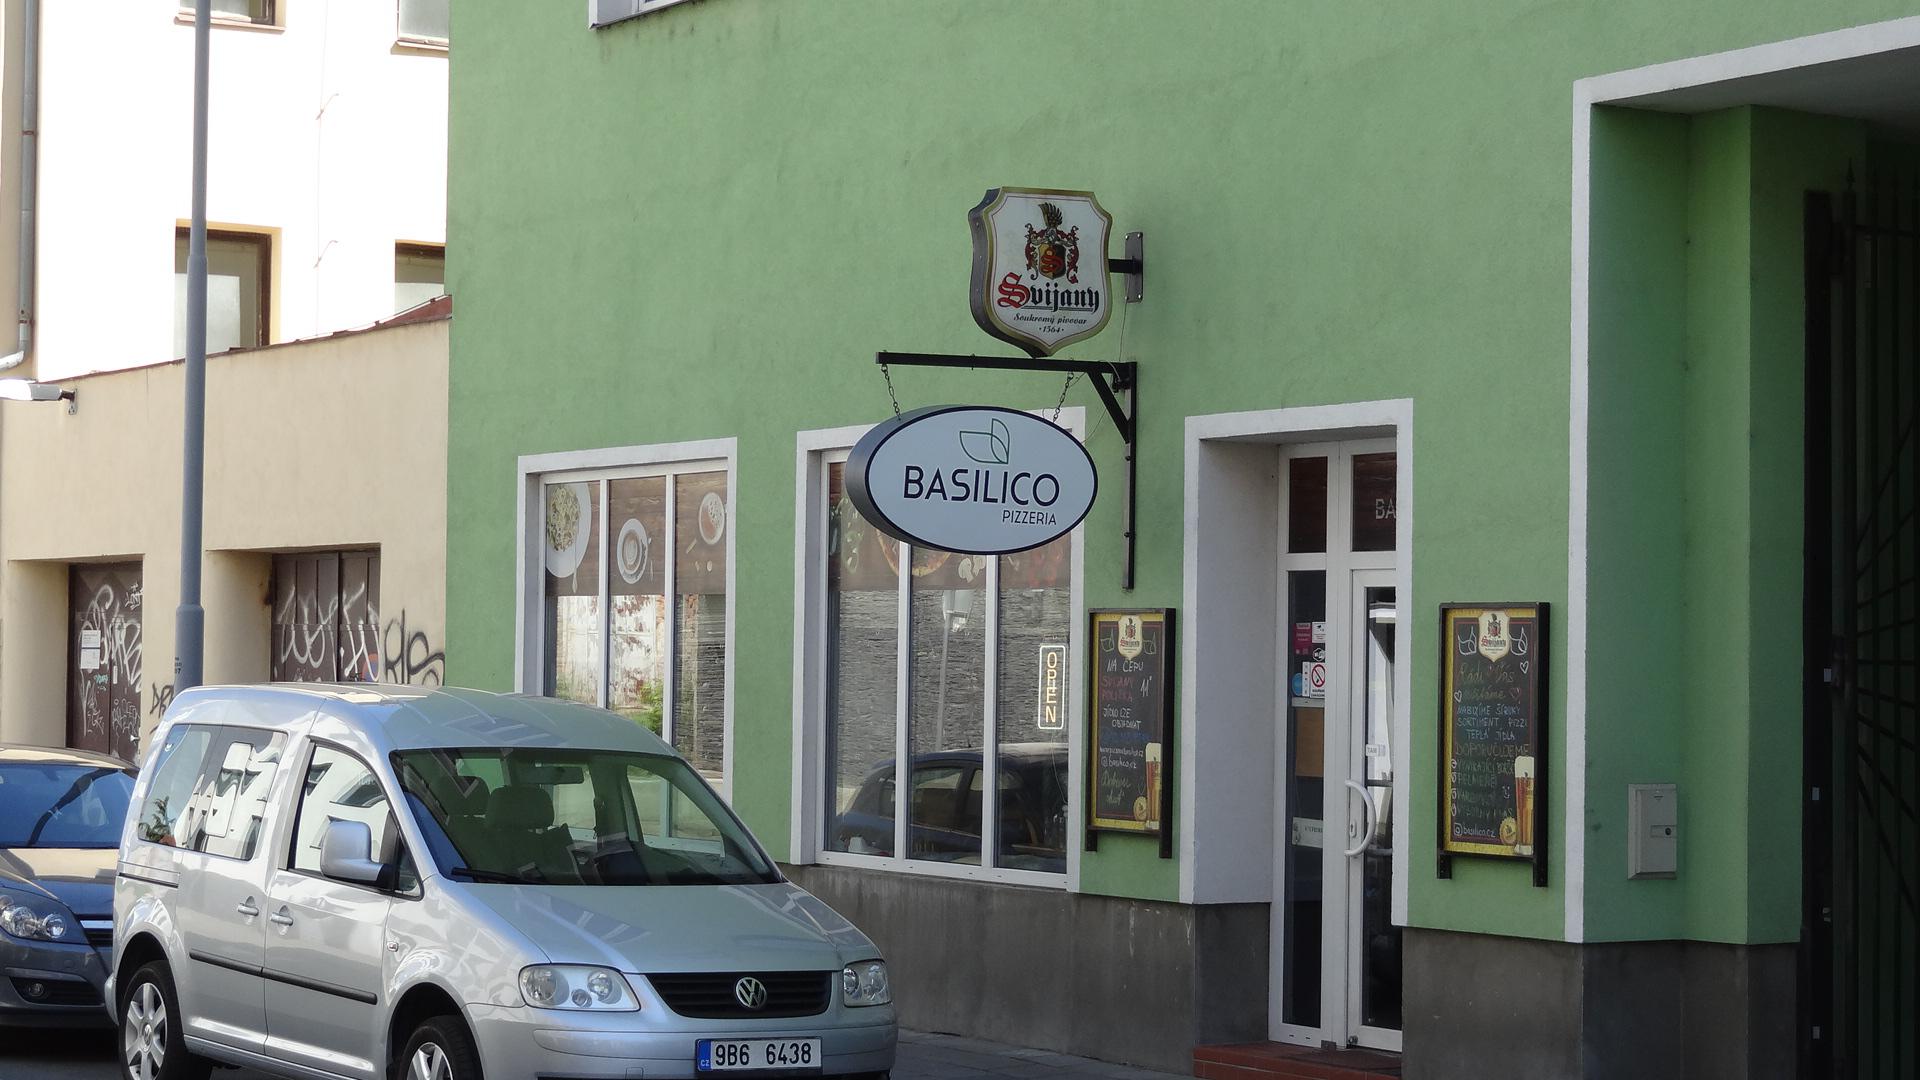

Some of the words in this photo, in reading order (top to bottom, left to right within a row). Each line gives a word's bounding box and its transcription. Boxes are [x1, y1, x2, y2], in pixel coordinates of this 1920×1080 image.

[997, 271, 1100, 315] Svijany
[903, 465, 1060, 507] BASILICO
[1002, 509, 1057, 526] PIZZERIA
[1045, 651, 1057, 723] OPEN
[700, 1059, 710, 1067] CZ
[715, 1043, 750, 1066] 9B6
[765, 1042, 812, 1065] 6438
